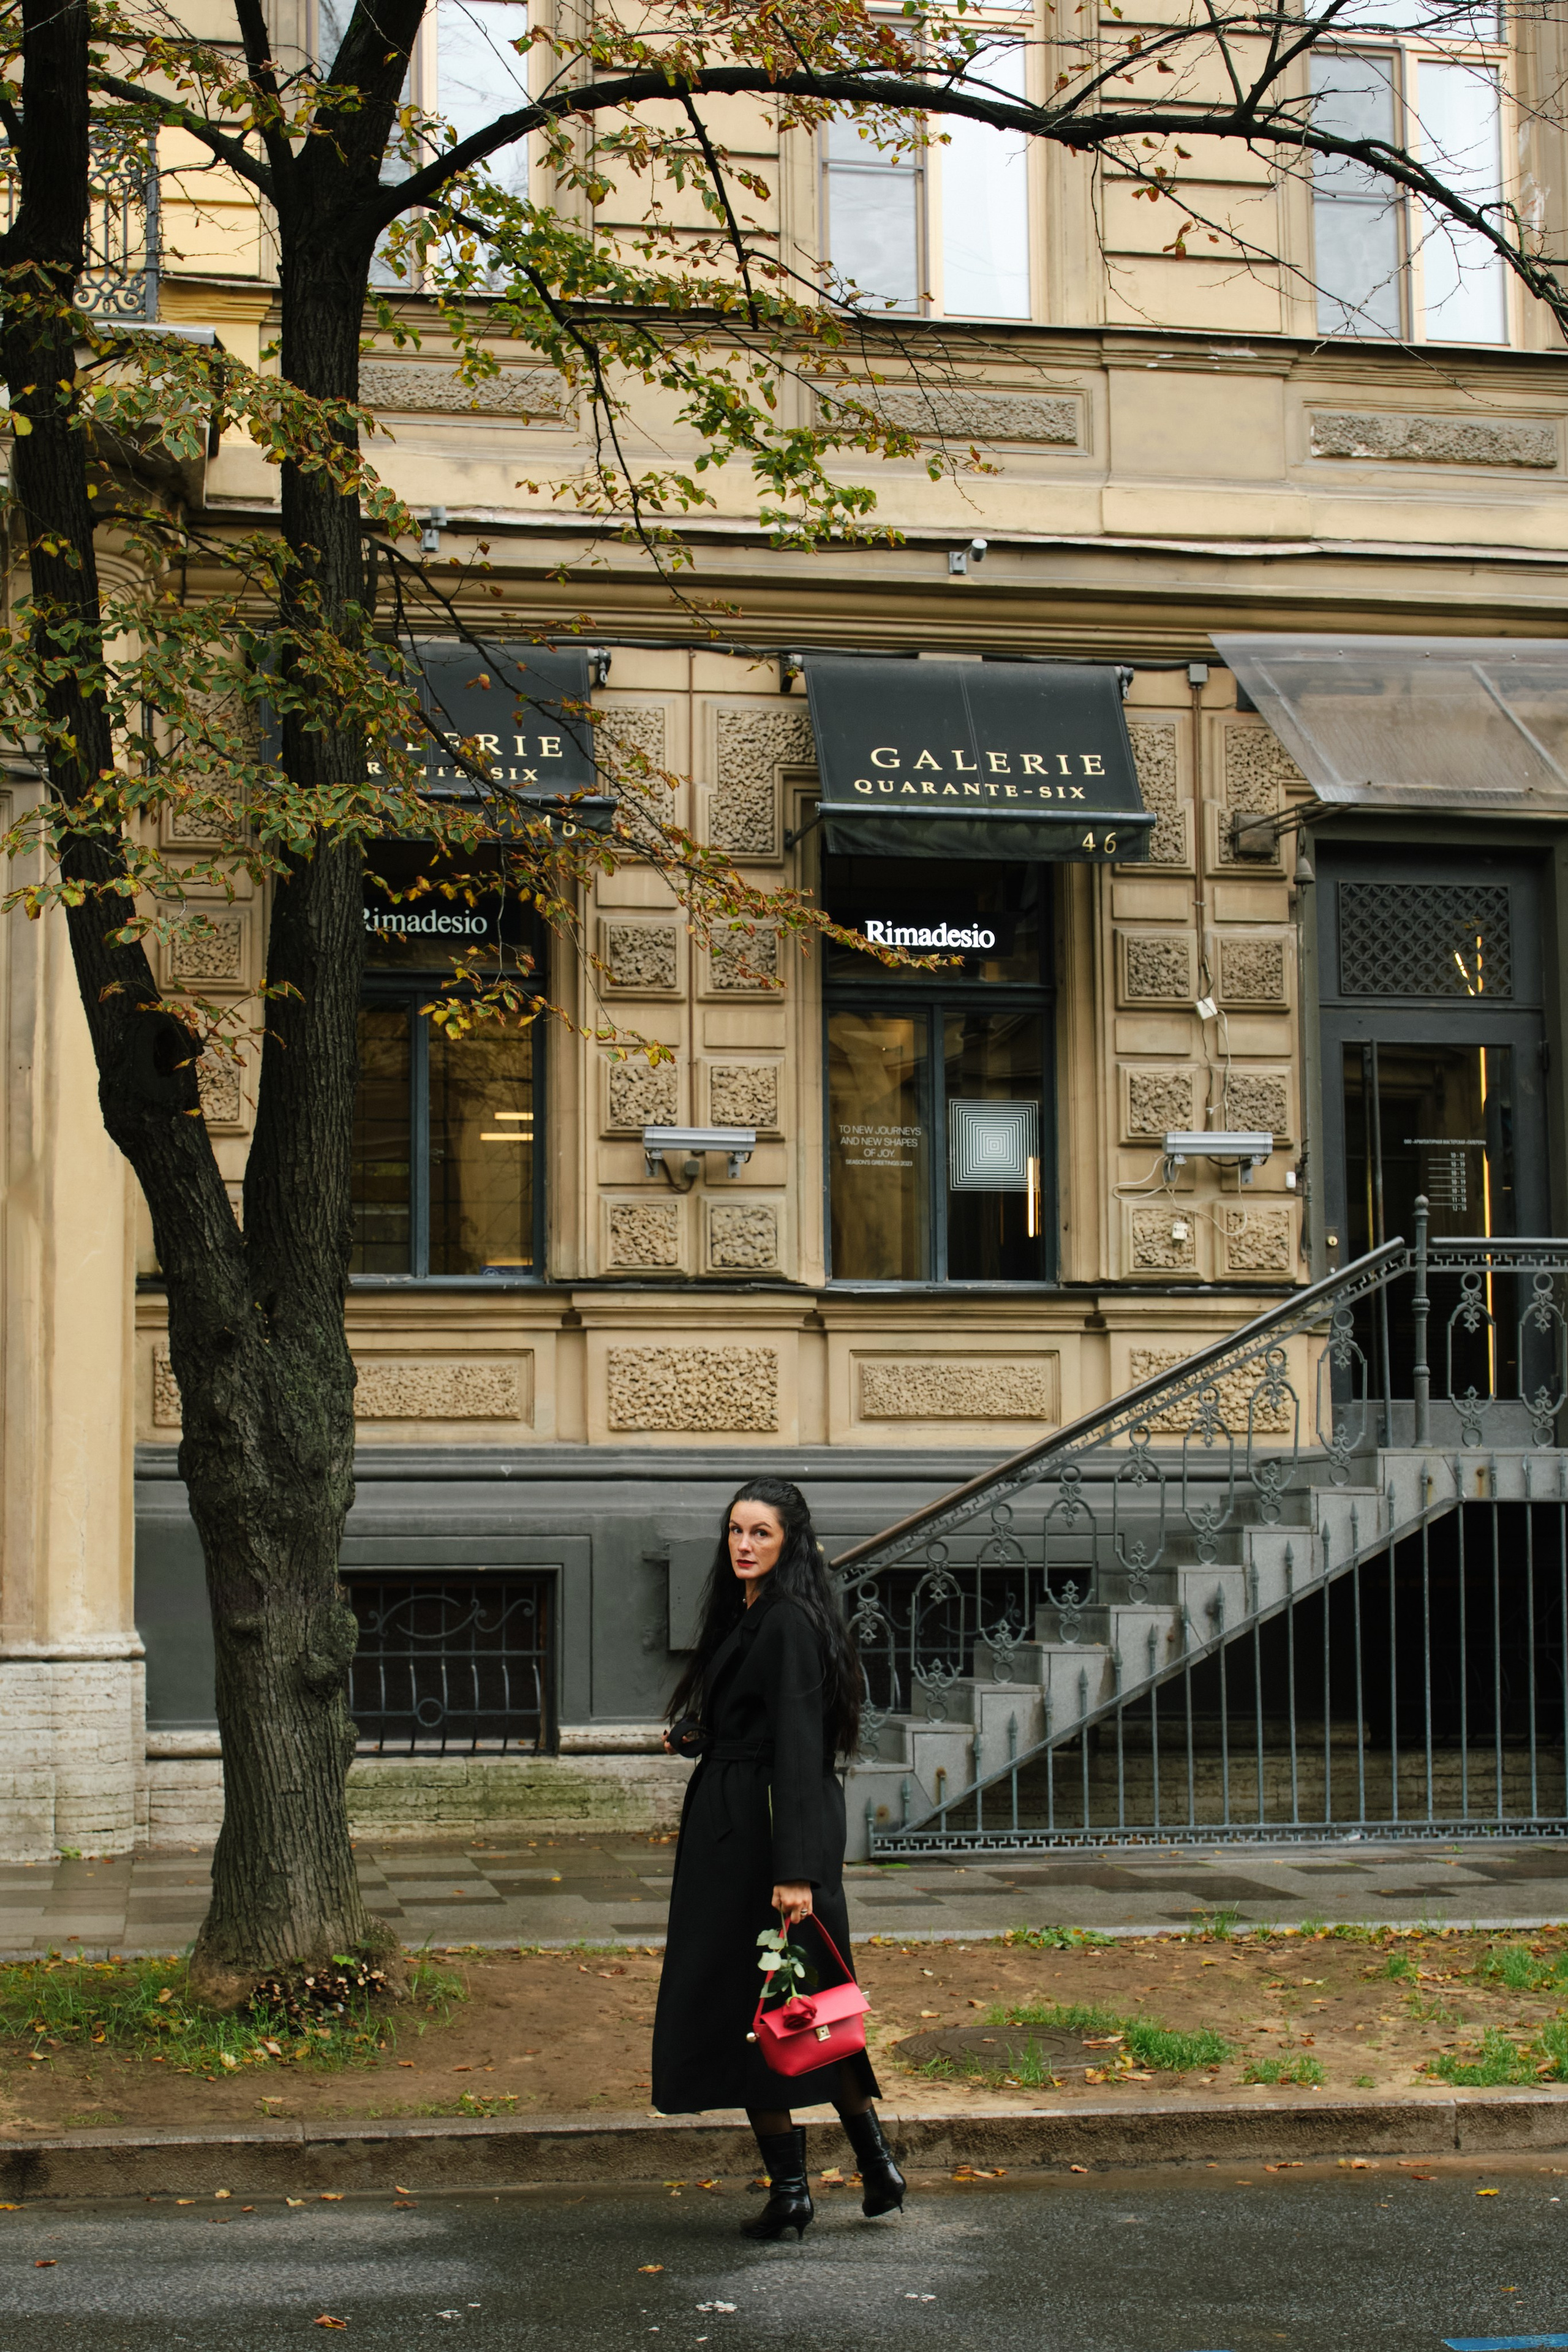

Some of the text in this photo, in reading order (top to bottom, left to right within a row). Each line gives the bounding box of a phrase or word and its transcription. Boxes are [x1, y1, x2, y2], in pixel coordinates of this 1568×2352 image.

[870, 747, 1106, 775] GALERIE
[854, 779, 1086, 799] QUARANTE-SIX
[1082, 832, 1117, 854] 46
[864, 920, 995, 948] Rimadesio
[839, 1125, 921, 1136] TO NEW JOURNEYS
[840, 1136, 918, 1147] AND NEW SHAPES
[864, 1148, 875, 1157] OF
